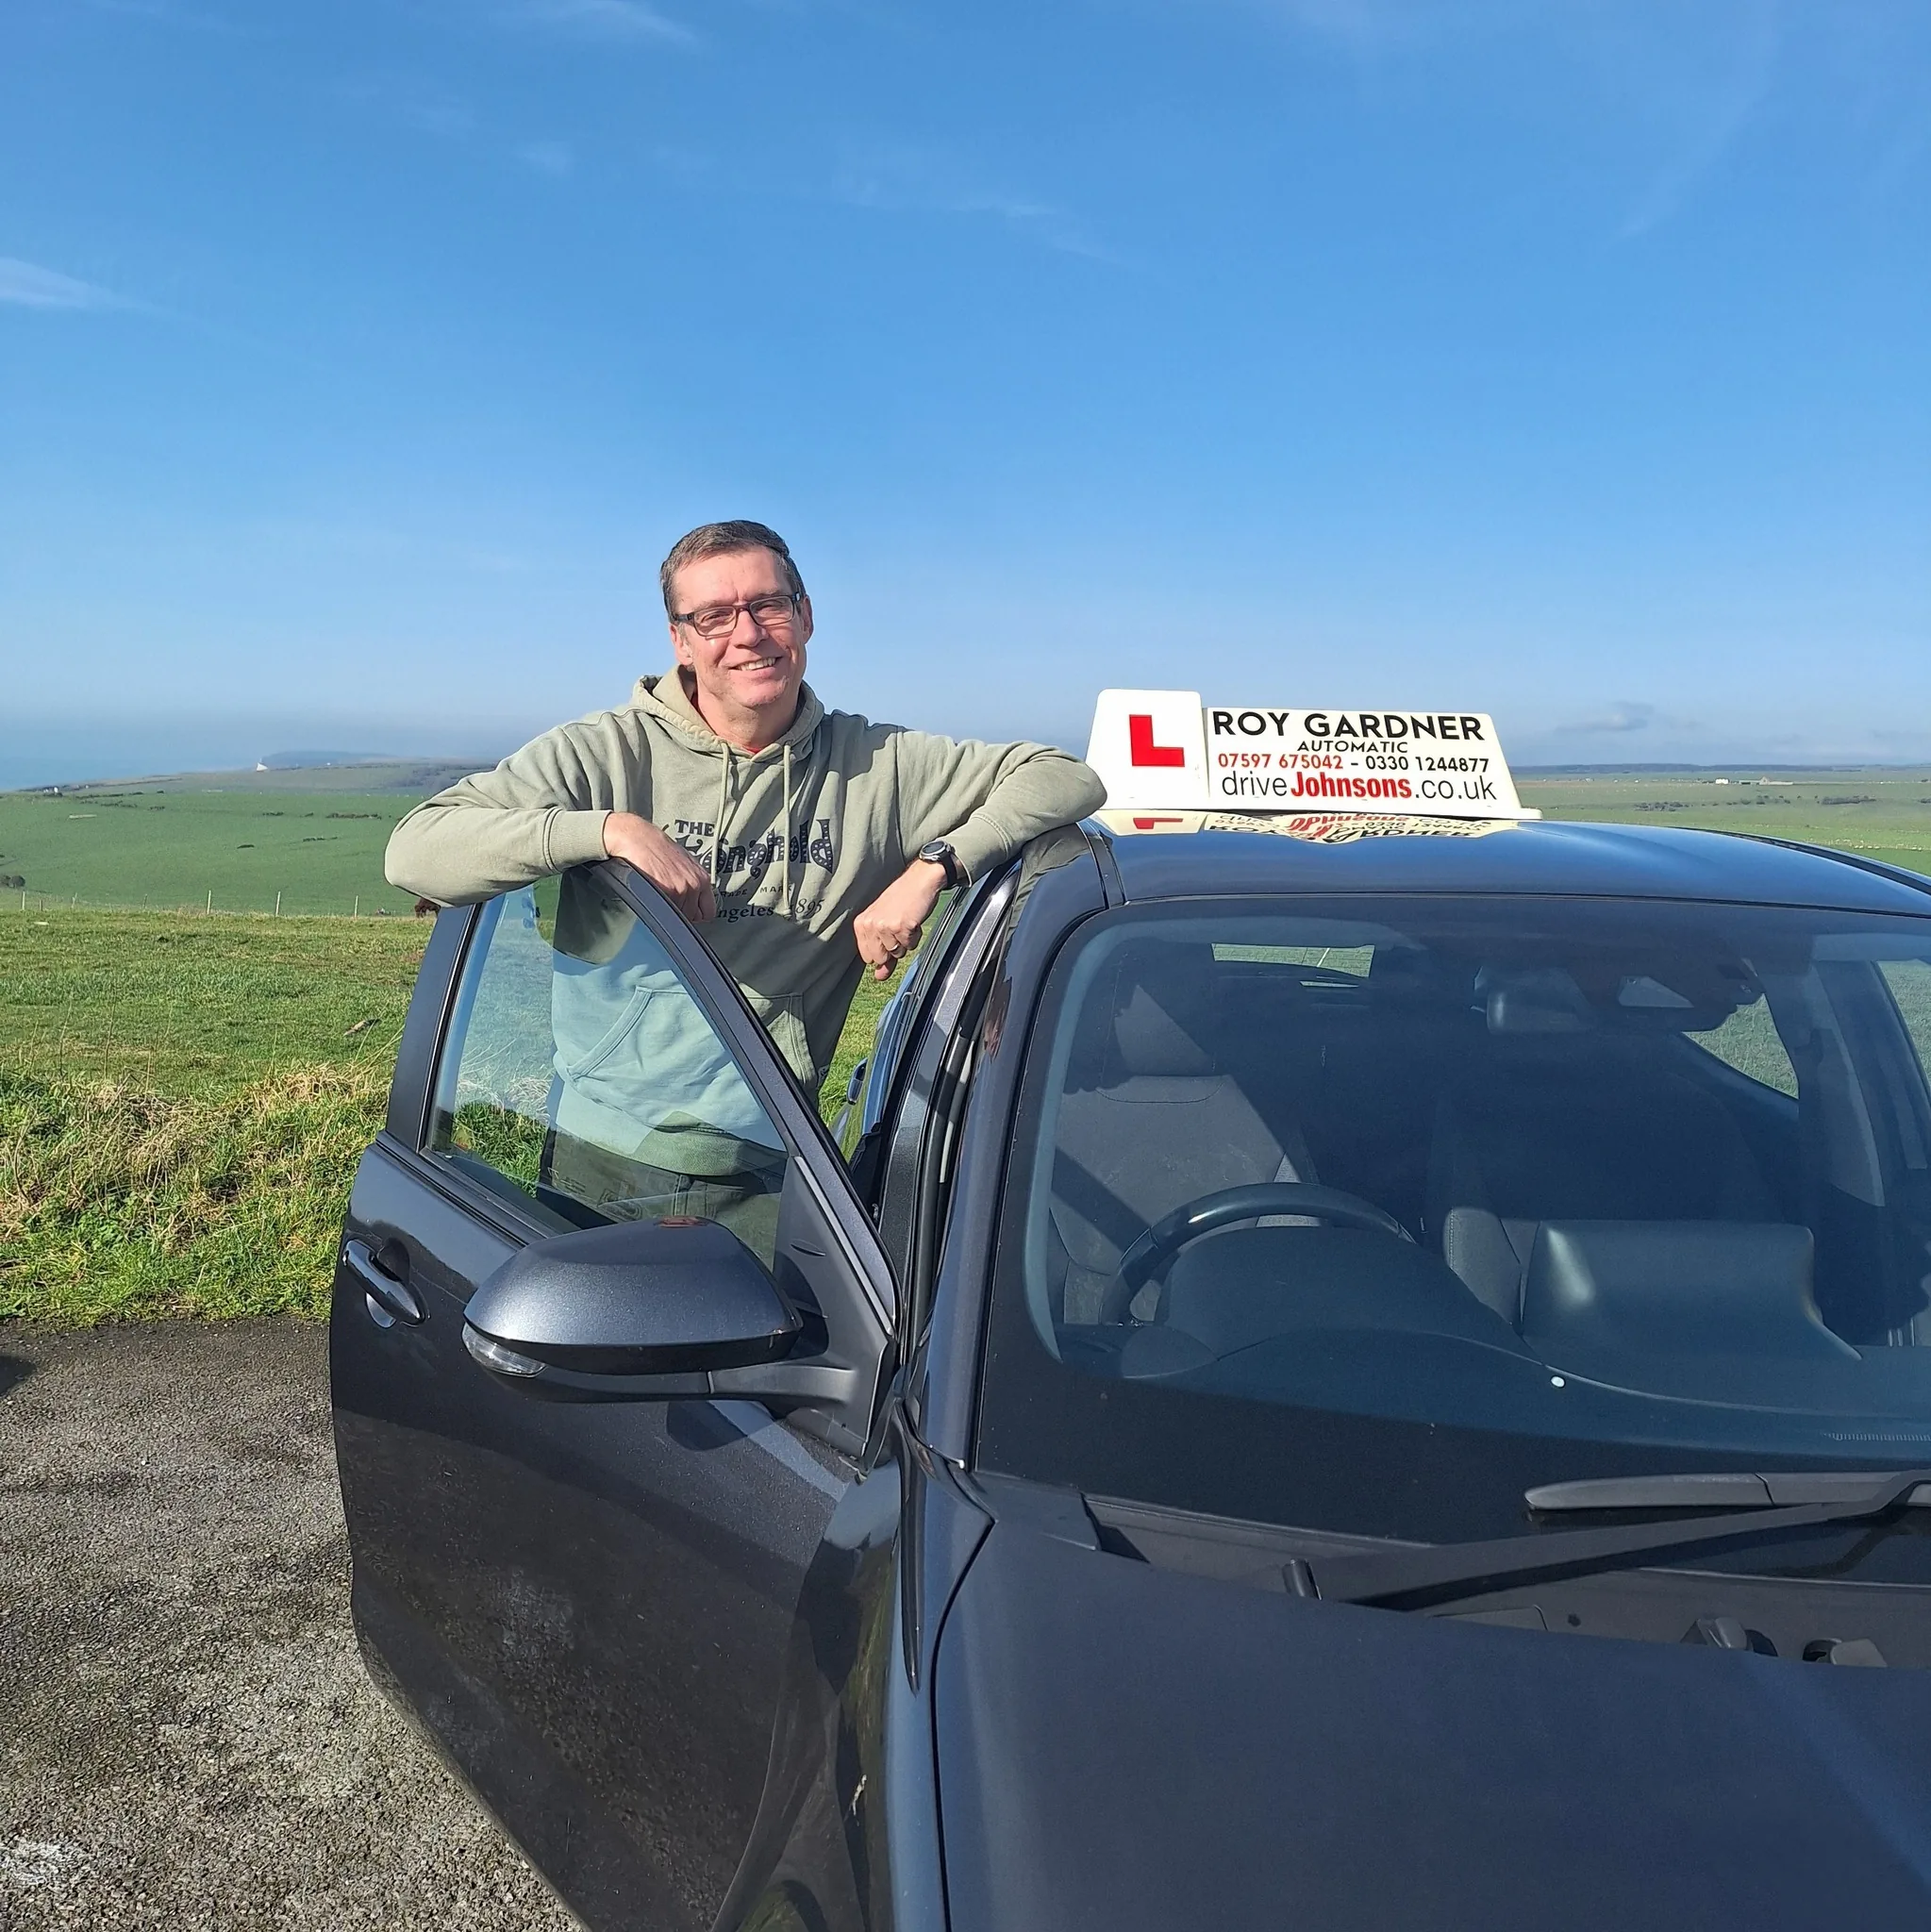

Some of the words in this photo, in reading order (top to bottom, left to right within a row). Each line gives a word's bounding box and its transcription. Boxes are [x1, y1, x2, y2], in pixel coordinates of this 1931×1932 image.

[1212, 710, 1290, 737] ROY
[1304, 713, 1486, 741] GARDNER
[1128, 714, 1186, 768] L
[1297, 740, 1408, 754] AUTOMATIC
[1218, 753, 1272, 768] 07597
[1278, 754, 1344, 770] 675042
[1365, 756, 1409, 771] 0330
[1415, 757, 1490, 773] 1244877
[674, 819, 716, 837] THE
[717, 903, 774, 923] ngeles
